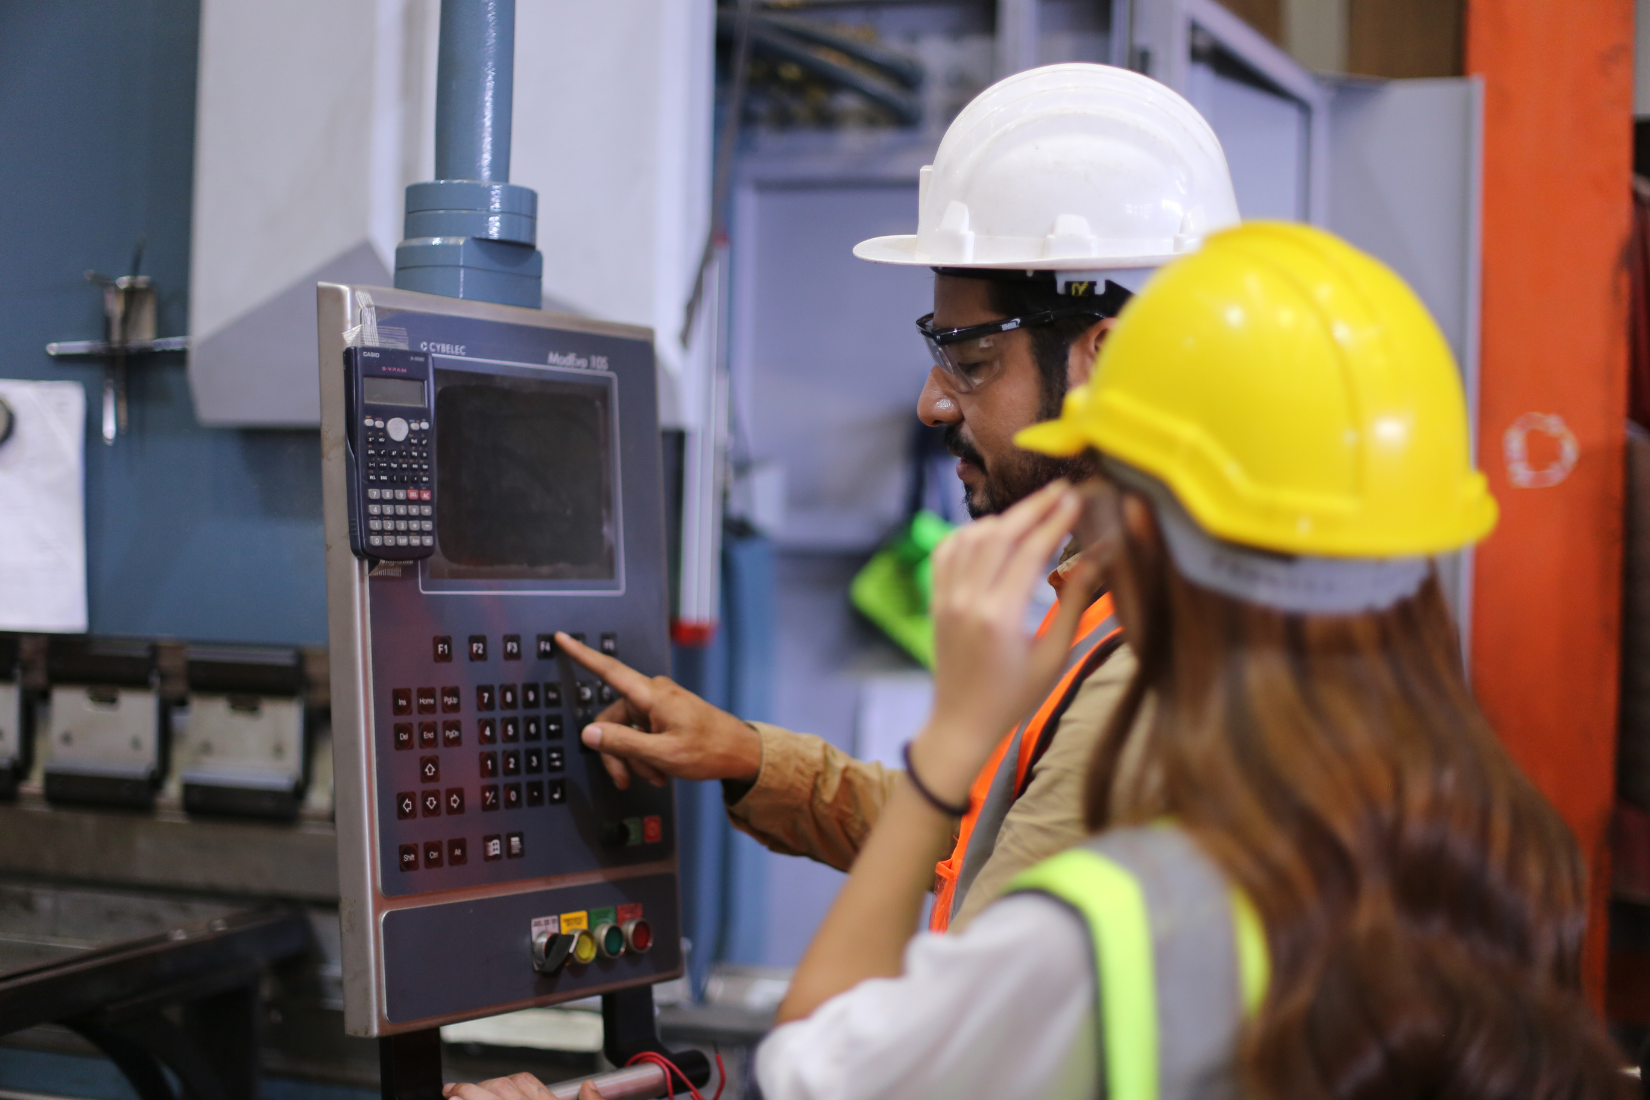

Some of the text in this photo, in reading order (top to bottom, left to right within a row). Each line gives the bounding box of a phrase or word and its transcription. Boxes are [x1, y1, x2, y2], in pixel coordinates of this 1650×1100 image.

[429, 342, 466, 356] CYBELEC
[438, 643, 448, 654] F1
[472, 642, 484, 654] F2
[507, 642, 518, 654] F3
[540, 641, 551, 652] F4
[419, 697, 435, 705] Home
[443, 695, 459, 705] PgUp
[483, 692, 489, 703] 7
[506, 691, 513, 703] 8
[528, 690, 535, 702] 9
[399, 698, 407, 706] Ins
[445, 729, 460, 739] PgDn
[484, 726, 491, 736] 4
[507, 724, 514, 735] 5
[529, 723, 536, 734] 6
[399, 732, 409, 741] Del
[423, 731, 434, 740] End
[508, 757, 515, 769] 2
[531, 755, 538, 767] 3
[510, 790, 517, 802] 0
[429, 850, 439, 859] Ctrl
[453, 848, 462, 856] Alt
[403, 854, 415, 862] Shift
